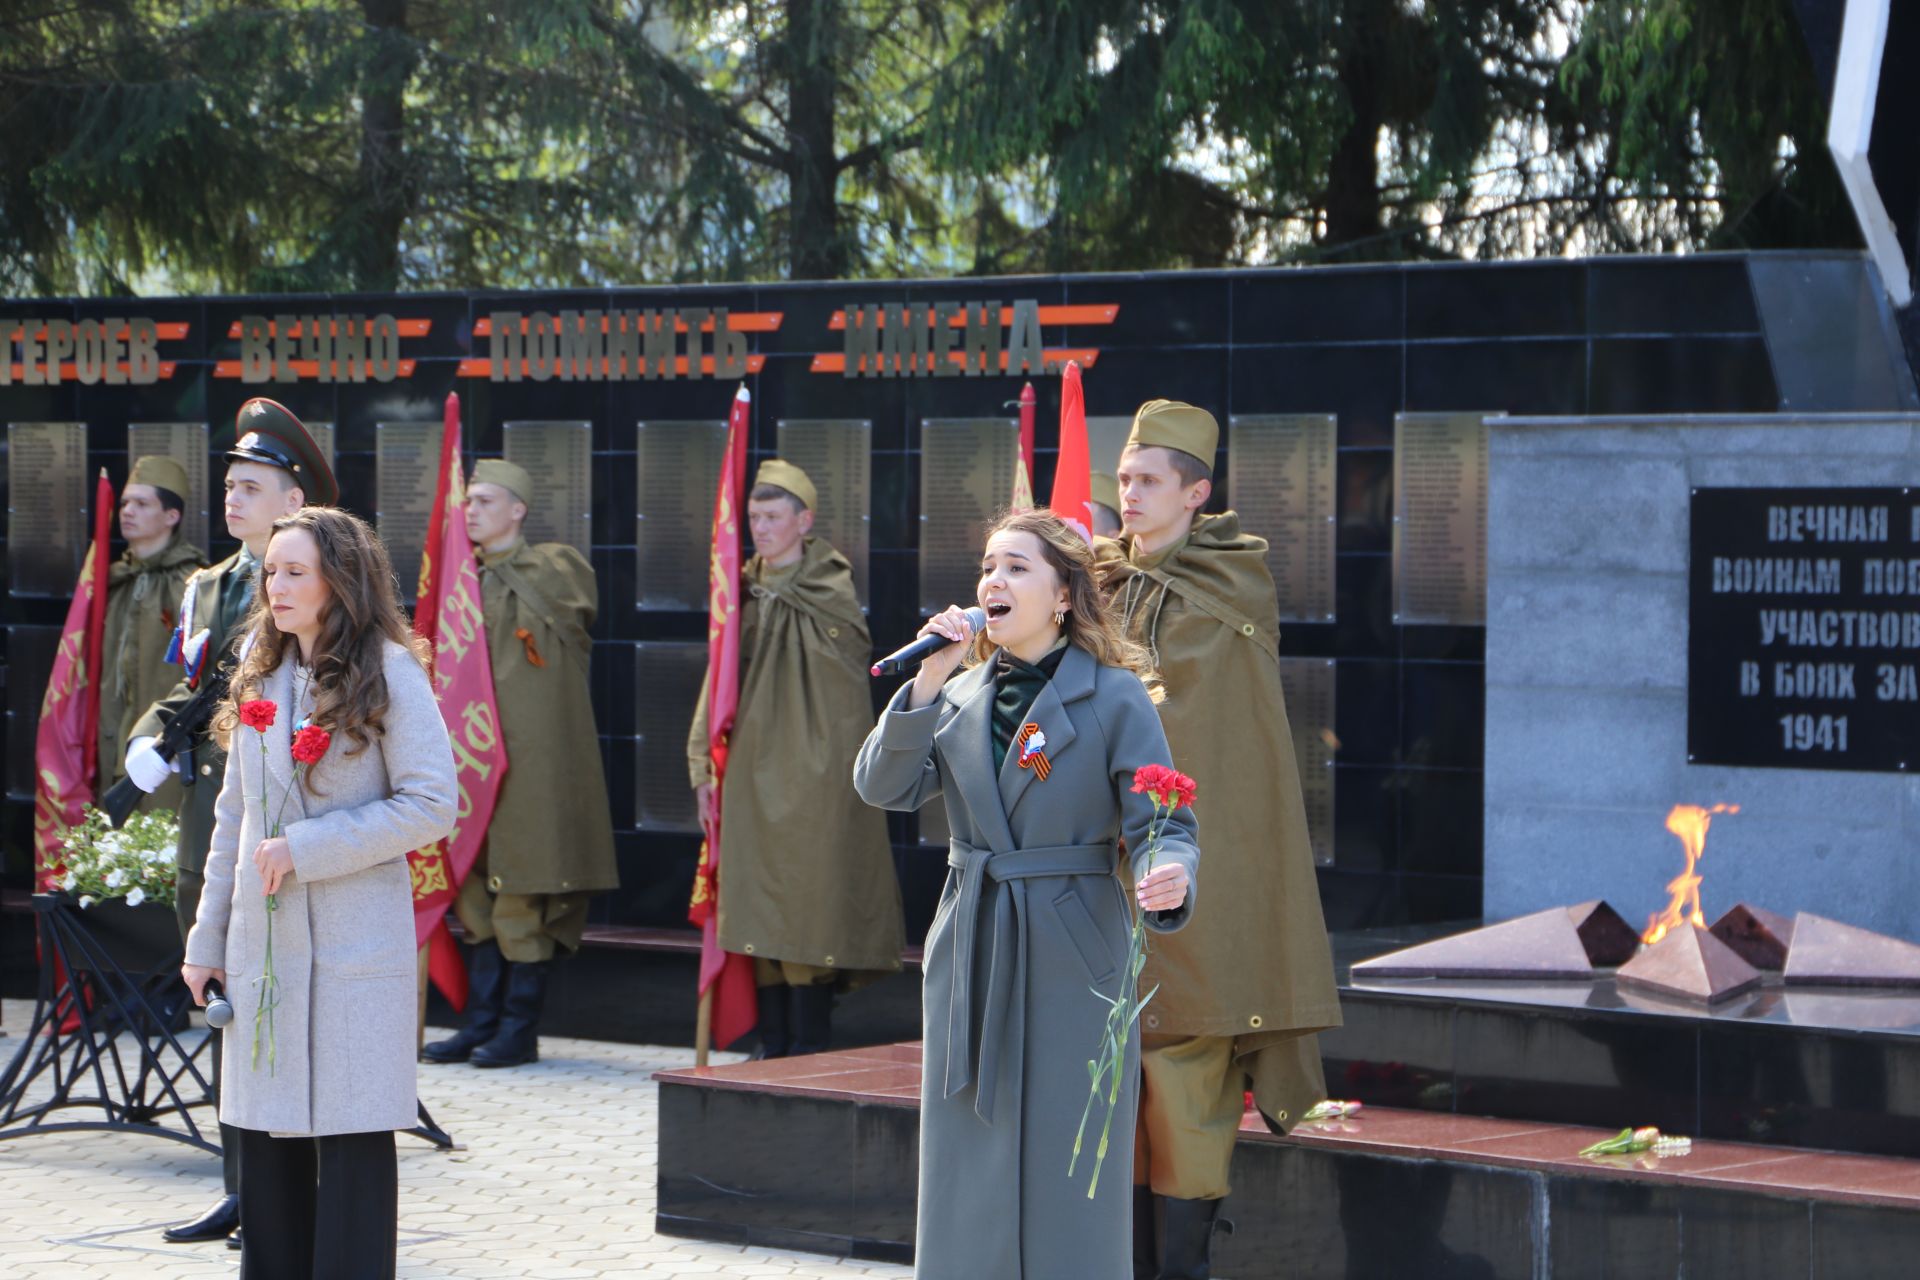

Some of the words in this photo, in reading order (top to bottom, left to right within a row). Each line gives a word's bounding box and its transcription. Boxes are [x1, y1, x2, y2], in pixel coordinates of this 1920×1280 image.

[0, 318, 159, 386] ГЕРОЕВ
[240, 313, 399, 383] ВЕЧНО
[490, 307, 747, 382] ПОМНИТЬ
[1768, 506, 1888, 542] ВЕЧНАЯ
[1712, 557, 1841, 593] ВОИНАМ
[1760, 610, 1920, 648] УЧАСТВОВ
[1740, 661, 1760, 697] В
[1774, 662, 1856, 698] БОЯХ
[1876, 664, 1918, 700] ЗА
[1779, 715, 1848, 751] 1941
